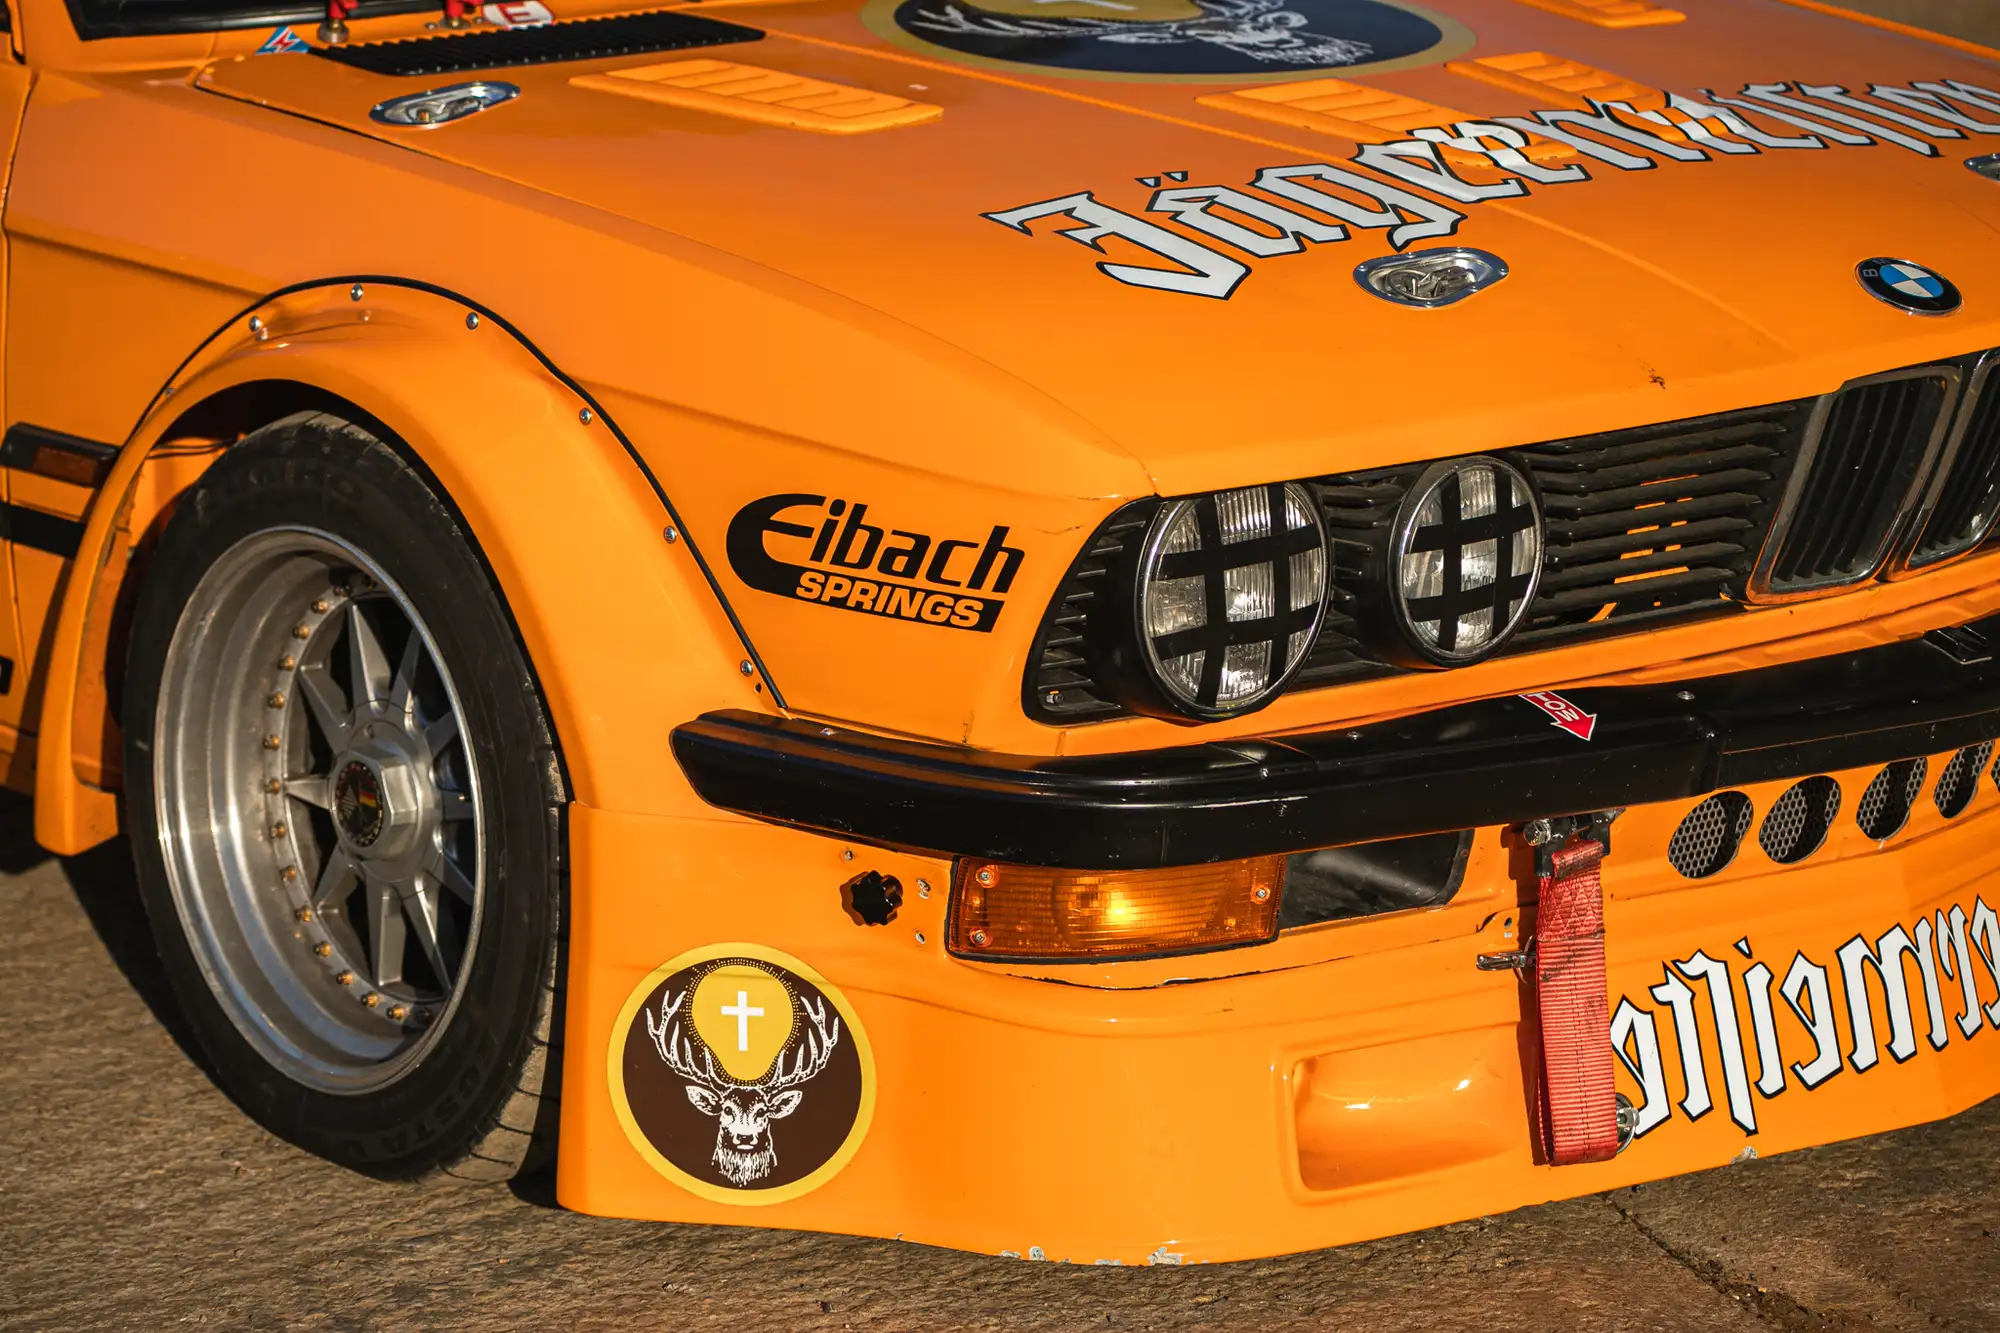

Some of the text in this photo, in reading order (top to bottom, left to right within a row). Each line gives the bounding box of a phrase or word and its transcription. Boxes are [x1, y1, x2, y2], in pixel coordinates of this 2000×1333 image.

[726, 493, 1026, 594] Eibach
[795, 571, 985, 628] SPRINGS
[1527, 691, 1580, 722] TOW
